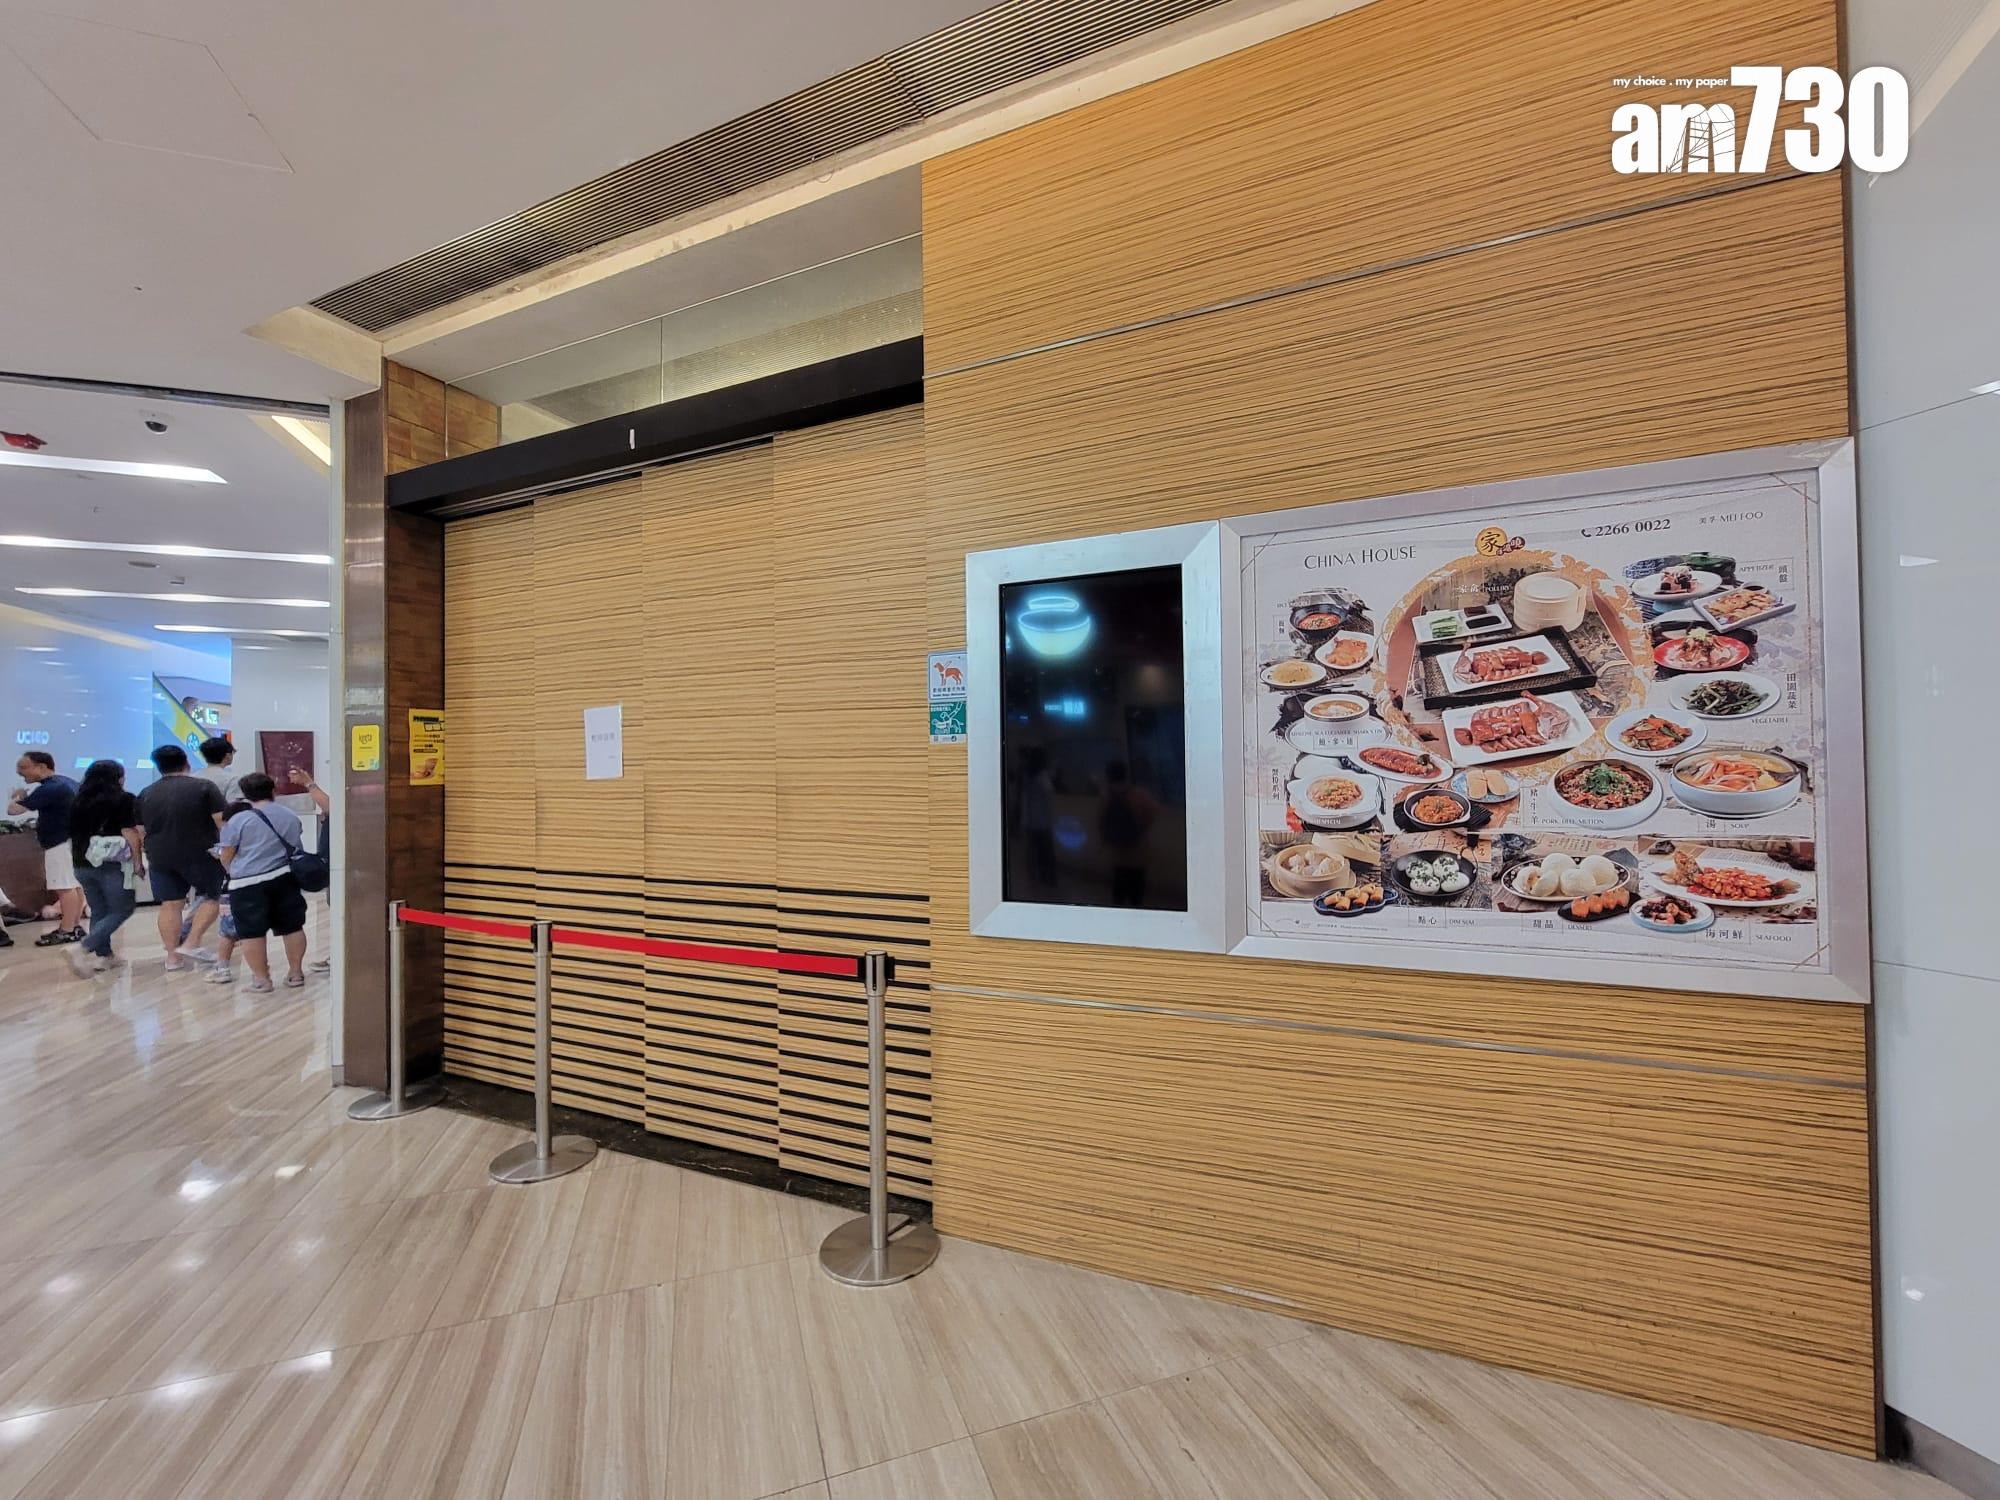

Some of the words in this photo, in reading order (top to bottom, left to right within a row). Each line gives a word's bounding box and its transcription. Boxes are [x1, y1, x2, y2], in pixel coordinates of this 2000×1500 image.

[1594, 524, 1630, 537] 2266
[1635, 518, 1671, 533] 0022
[1304, 552, 1356, 570] CHINA
[1362, 545, 1417, 563] HOUSE
[1418, 915, 1438, 925] 點心
[1532, 919, 1554, 929] 甜品
